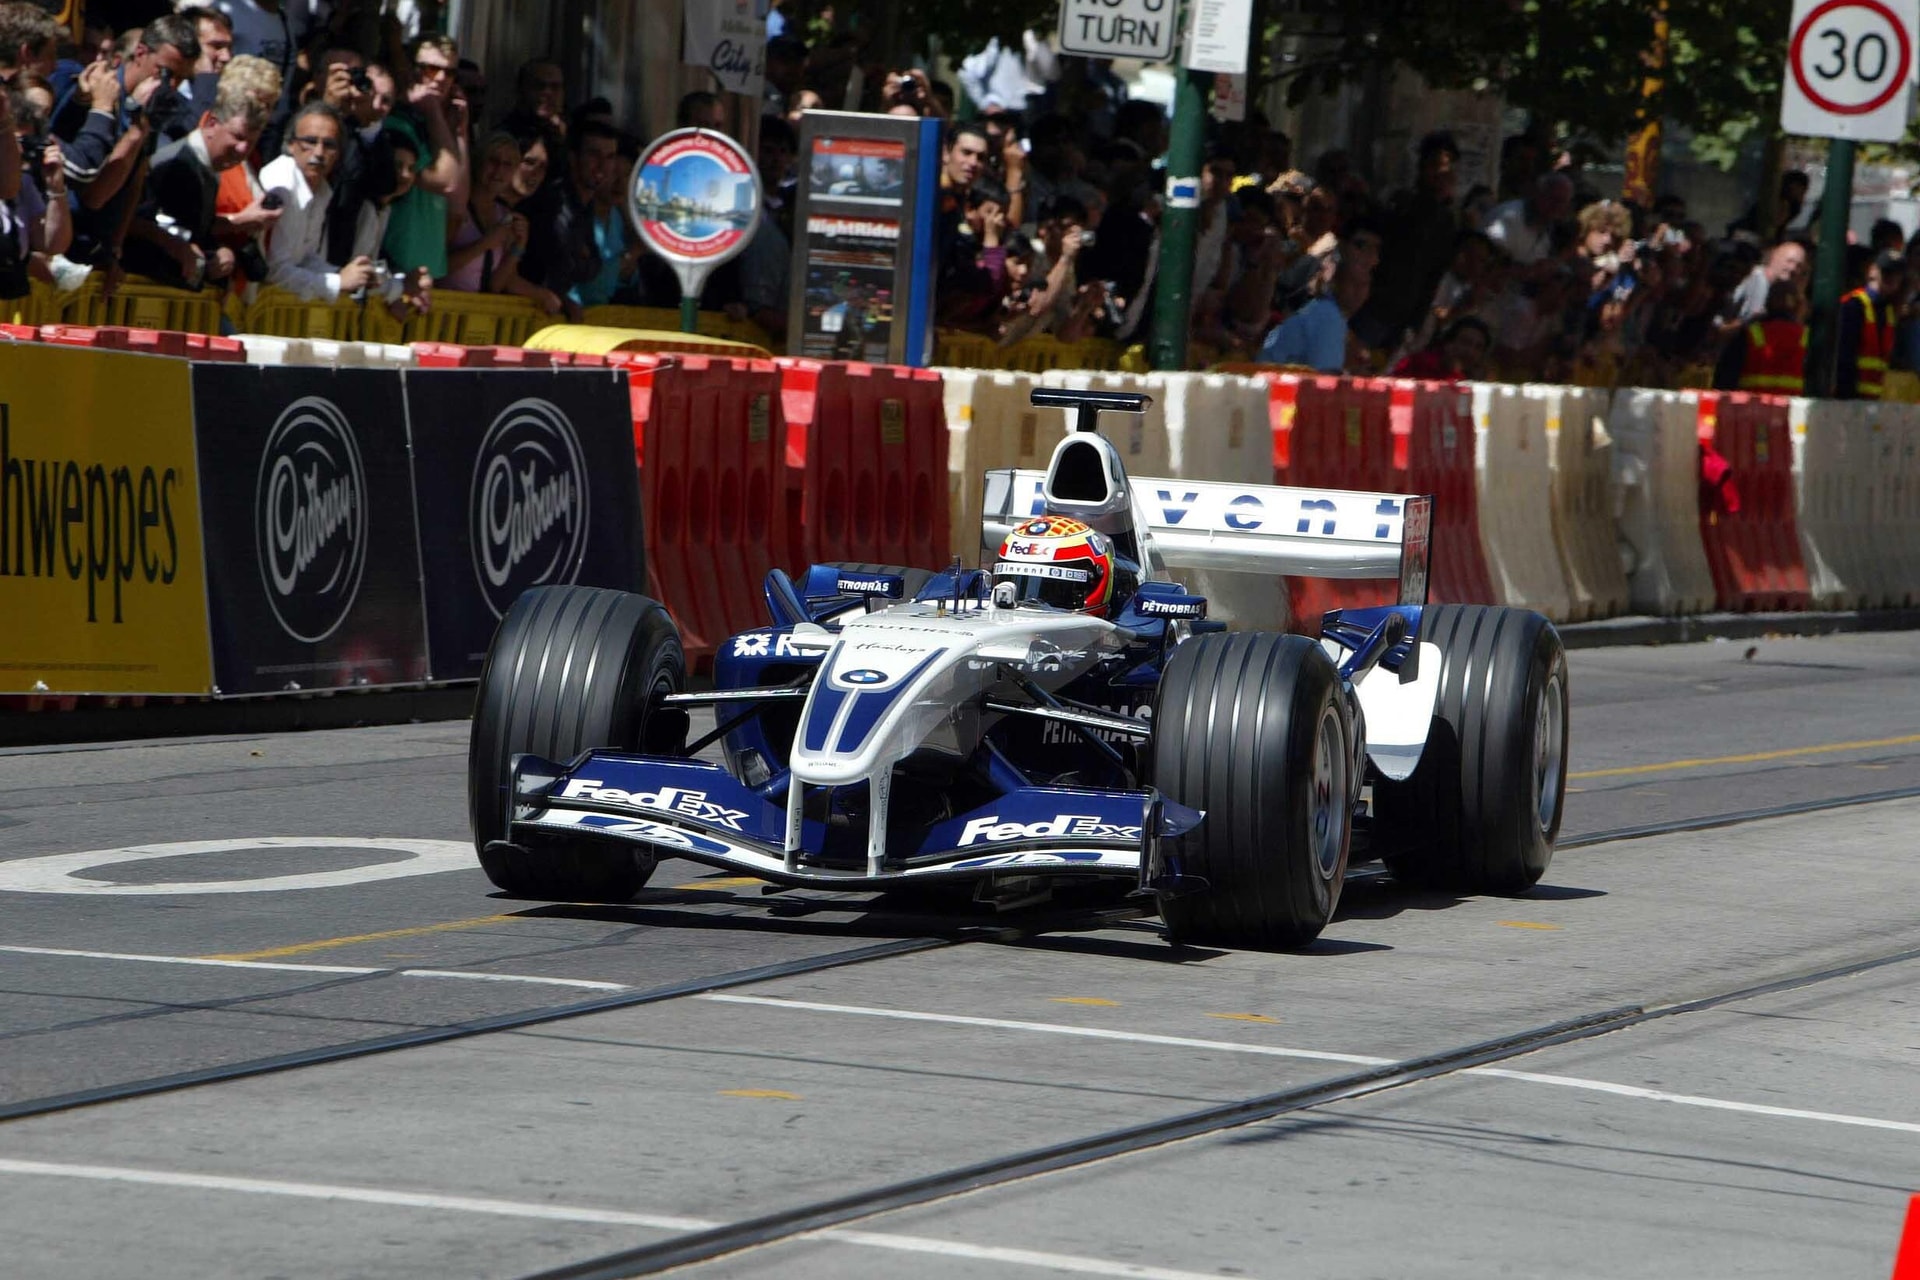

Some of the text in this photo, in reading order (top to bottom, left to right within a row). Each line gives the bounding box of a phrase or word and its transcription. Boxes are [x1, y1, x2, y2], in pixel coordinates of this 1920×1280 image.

[1078, 14, 1160, 47] TURN
[710, 38, 751, 86] City
[1814, 29, 1888, 82] 30
[807, 217, 900, 239] NightRider
[0, 403, 178, 624] hweppes
[266, 455, 352, 595] Cadbury
[480, 454, 572, 587] Cadbury
[1010, 541, 1051, 556] FedEx
[1141, 601, 1201, 615] PETROBRAS
[561, 778, 750, 831] FedEx
[957, 814, 1142, 847] FedEx
